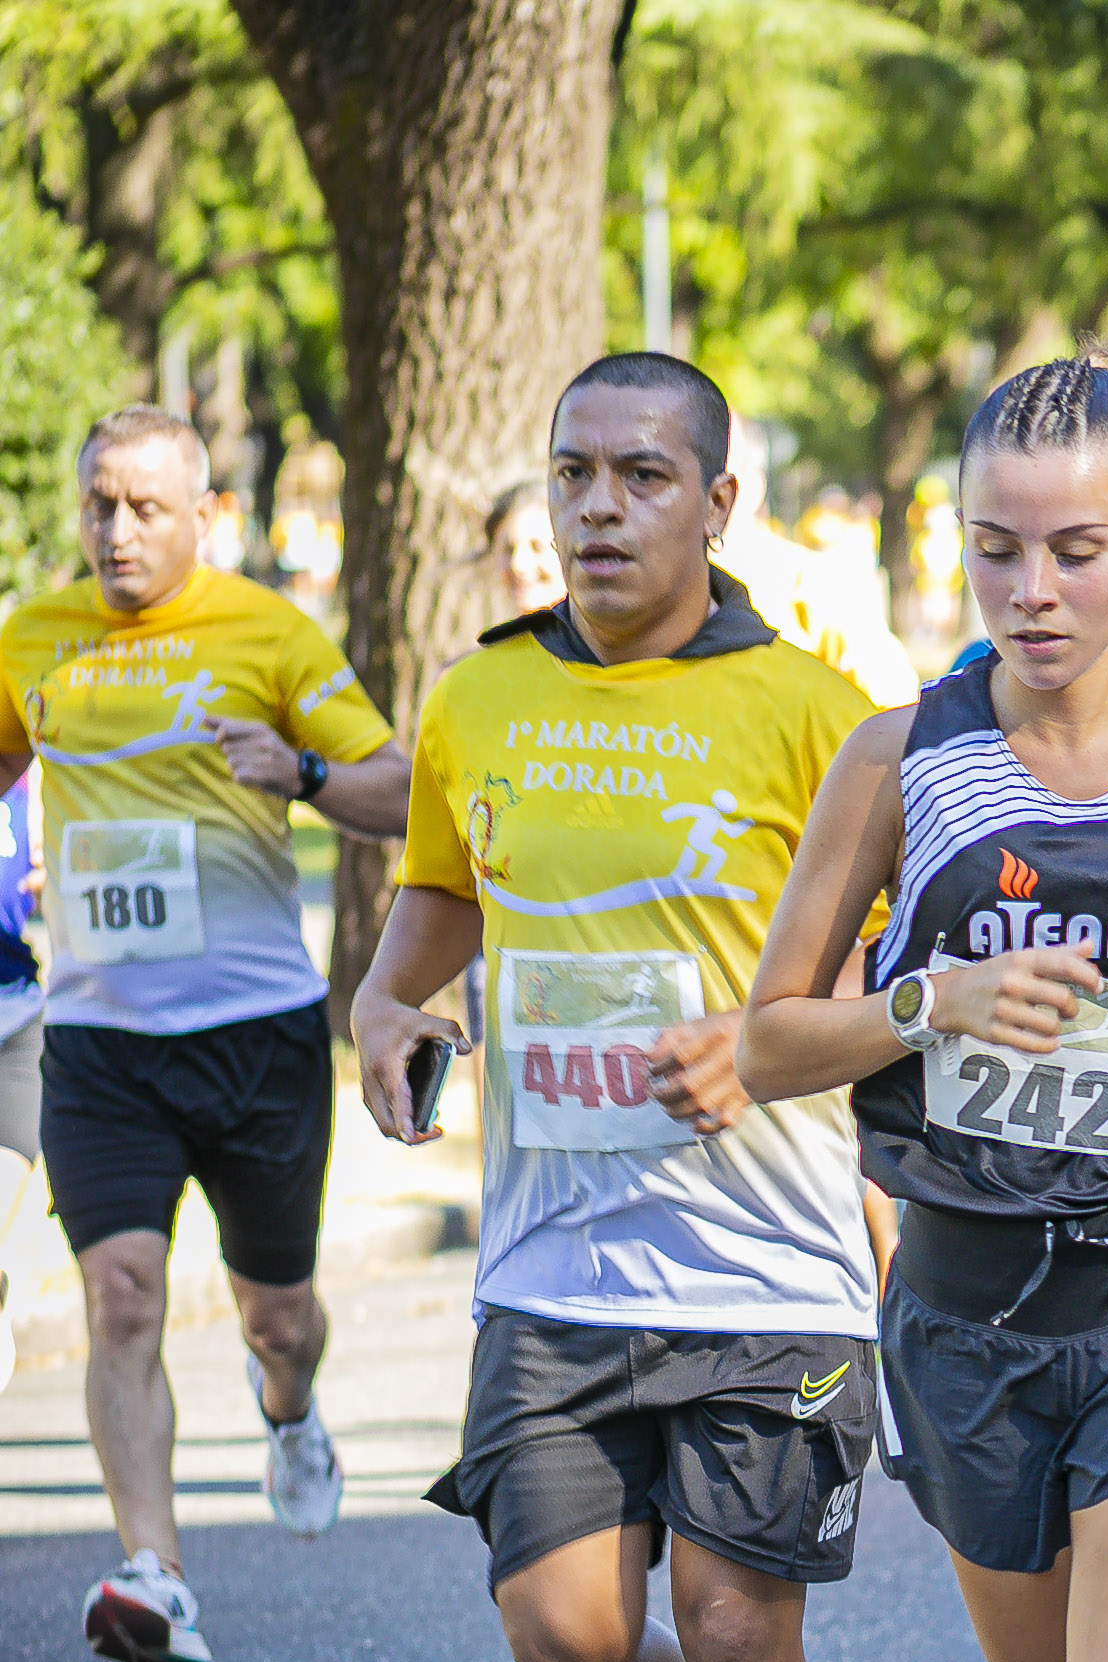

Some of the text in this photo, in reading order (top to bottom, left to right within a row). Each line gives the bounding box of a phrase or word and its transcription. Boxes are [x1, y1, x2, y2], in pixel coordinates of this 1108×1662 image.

[76, 634, 194, 660] MARATÓN
[69, 667, 166, 688] DORADA
[536, 720, 712, 764] MARATÓN
[522, 760, 669, 800] DORADA
[82, 883, 167, 930] 180
[523, 1043, 649, 1109] 440
